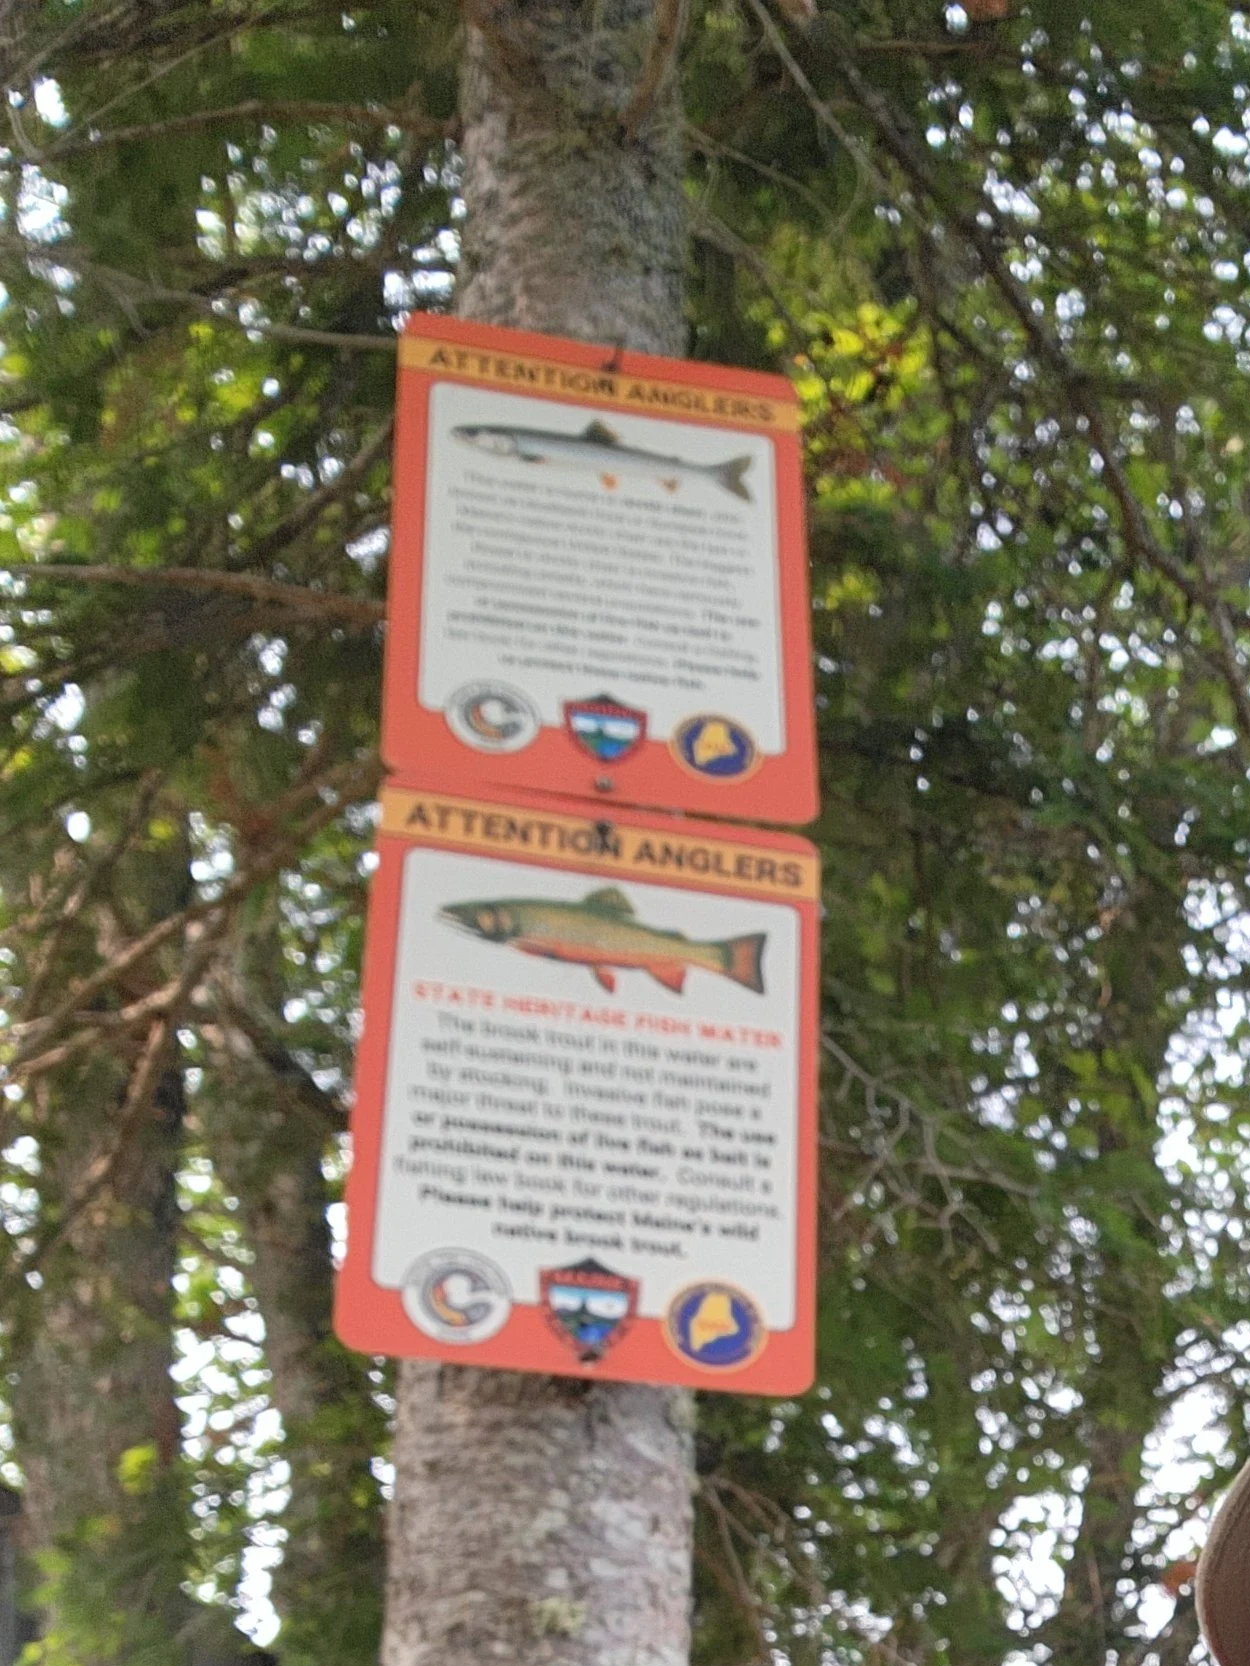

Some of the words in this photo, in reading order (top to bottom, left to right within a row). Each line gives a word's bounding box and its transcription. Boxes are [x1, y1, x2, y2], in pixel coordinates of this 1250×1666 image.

[428, 347, 616, 396] ATTENTION
[628, 384, 775, 422] ANGLERS
[406, 802, 622, 859] ATTENTION
[634, 839, 803, 887] ANGLERS
[413, 981, 494, 1010] STATE
[503, 997, 626, 1026] HERITAGE
[635, 1013, 690, 1034] FISH
[698, 1024, 782, 1047] WATER
[437, 1010, 475, 1032] The
[480, 1019, 540, 1041] brook
[545, 1028, 595, 1049] trout
[622, 1040, 659, 1060] this
[666, 1049, 720, 1067] water
[727, 1057, 757, 1073] are
[578, 1060, 616, 1079] and
[620, 1063, 654, 1081] not
[660, 1070, 771, 1099] maintained
[653, 1091, 687, 1109] fish
[695, 1100, 742, 1118] pose
[412, 1111, 434, 1127] or
[440, 1114, 560, 1141] possession
[566, 1128, 589, 1146] of
[595, 1133, 629, 1150] live
[637, 1137, 675, 1156] fish
[681, 1147, 703, 1161] as
[710, 1147, 748, 1166] bait
[698, 1120, 733, 1140] The
[741, 1130, 776, 1145] use
[393, 1154, 467, 1185] fishing
[571, 1179, 600, 1197] for
[606, 1186, 660, 1205] other
[409, 1135, 520, 1161] prohibited
[524, 1151, 551, 1166] on
[556, 1152, 596, 1172] this
[675, 1166, 755, 1191] Consult
[418, 1184, 490, 1209] Please
[498, 1193, 543, 1217] help
[549, 1203, 626, 1224] protect
[718, 1222, 760, 1243] wild
[493, 1221, 557, 1241] native
[564, 1226, 623, 1250] brook
